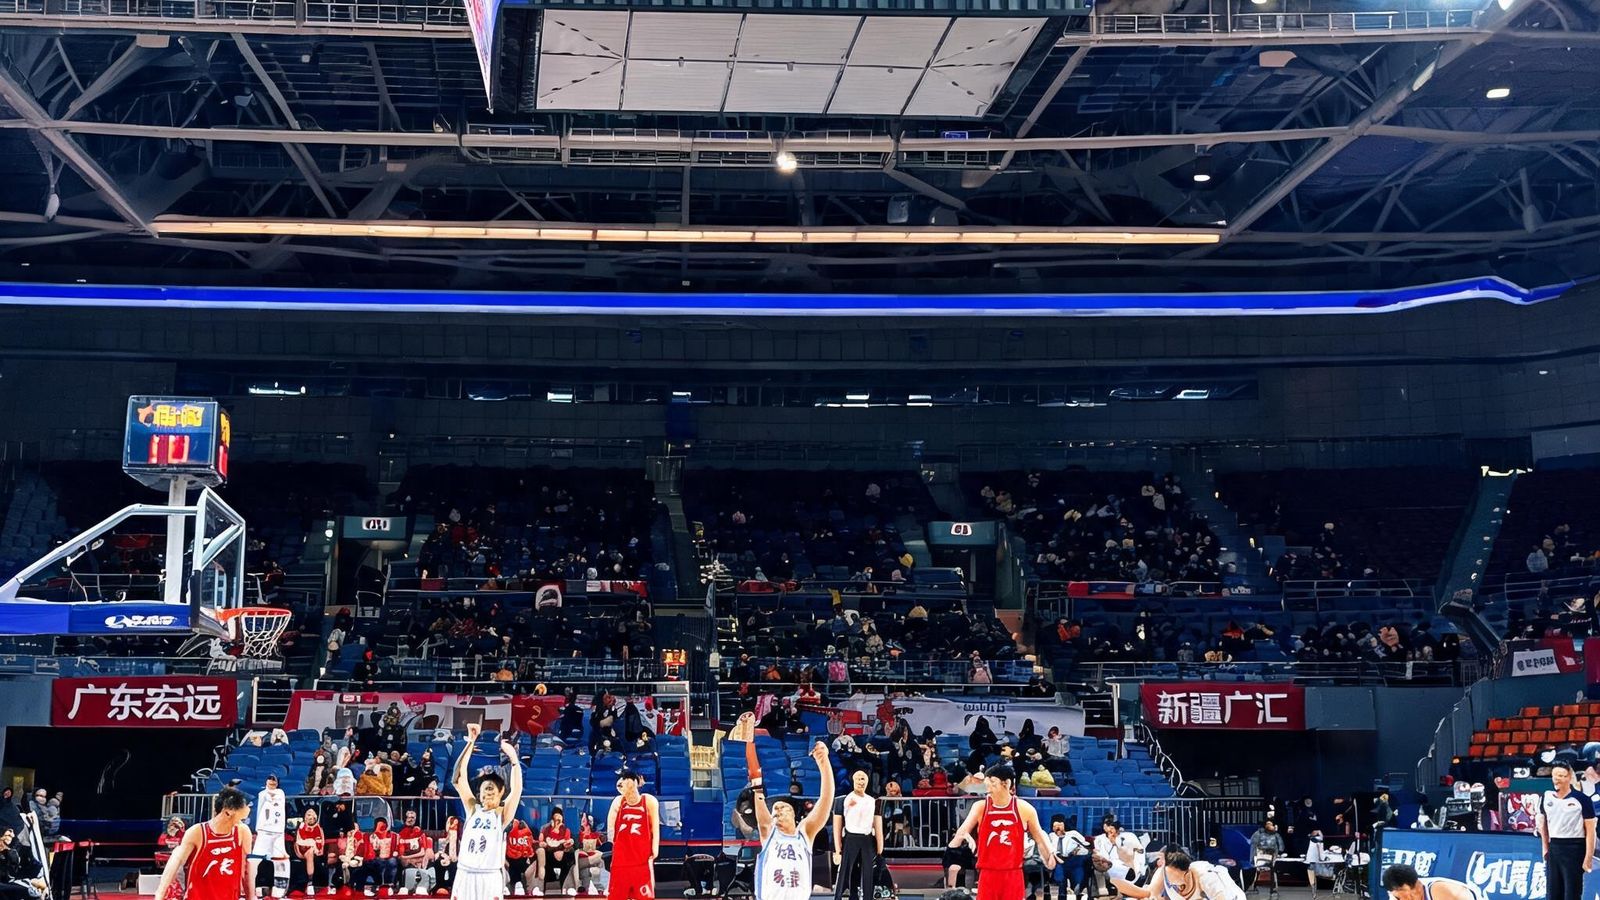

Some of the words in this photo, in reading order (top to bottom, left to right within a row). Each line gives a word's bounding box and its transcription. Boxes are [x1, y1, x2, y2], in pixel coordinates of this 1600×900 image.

[68, 683, 222, 721] 广东宏远
[1158, 691, 1288, 725] 新疆广汇
